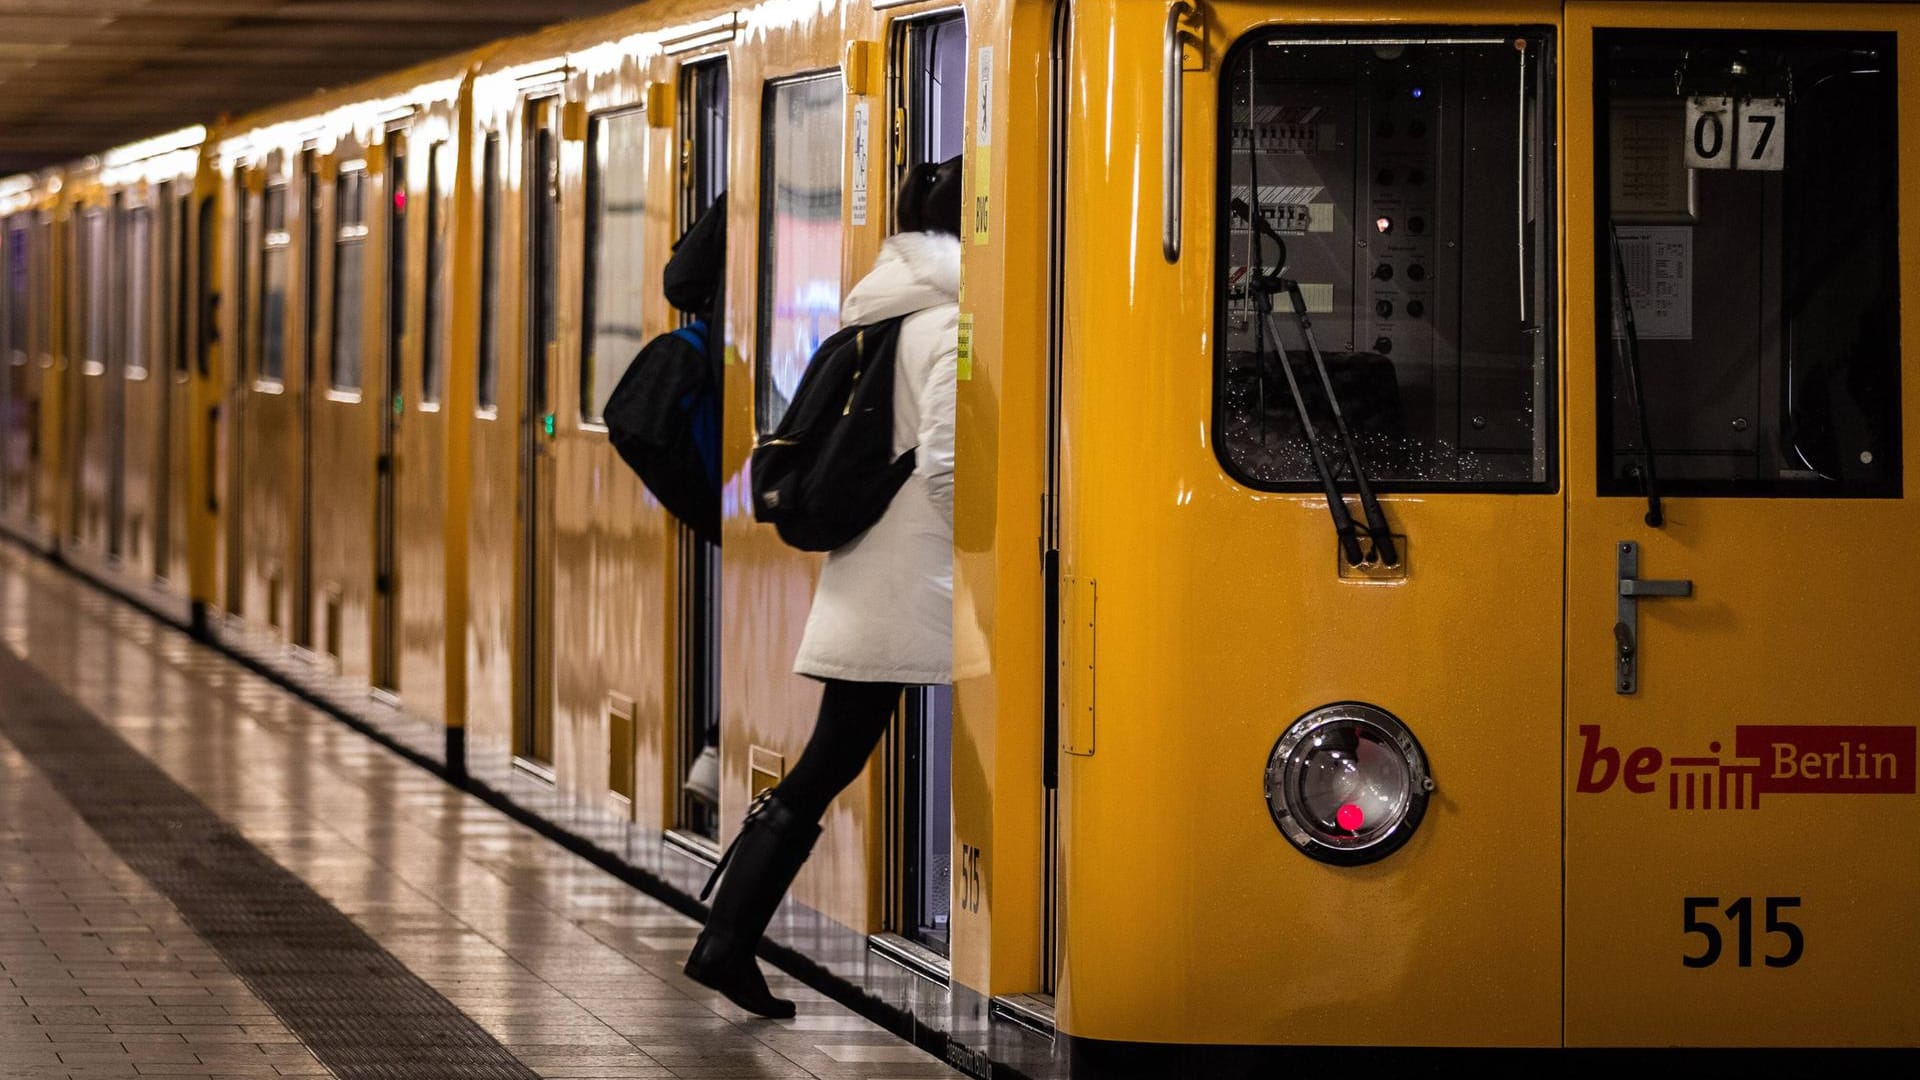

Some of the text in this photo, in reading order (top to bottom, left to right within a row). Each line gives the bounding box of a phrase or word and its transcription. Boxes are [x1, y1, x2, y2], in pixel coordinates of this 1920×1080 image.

[1694, 111, 1776, 160] 07
[976, 195, 988, 233] BVG
[1576, 725, 1897, 793] be Berlin
[962, 844, 980, 914] 515
[1683, 896, 1804, 968] 515
